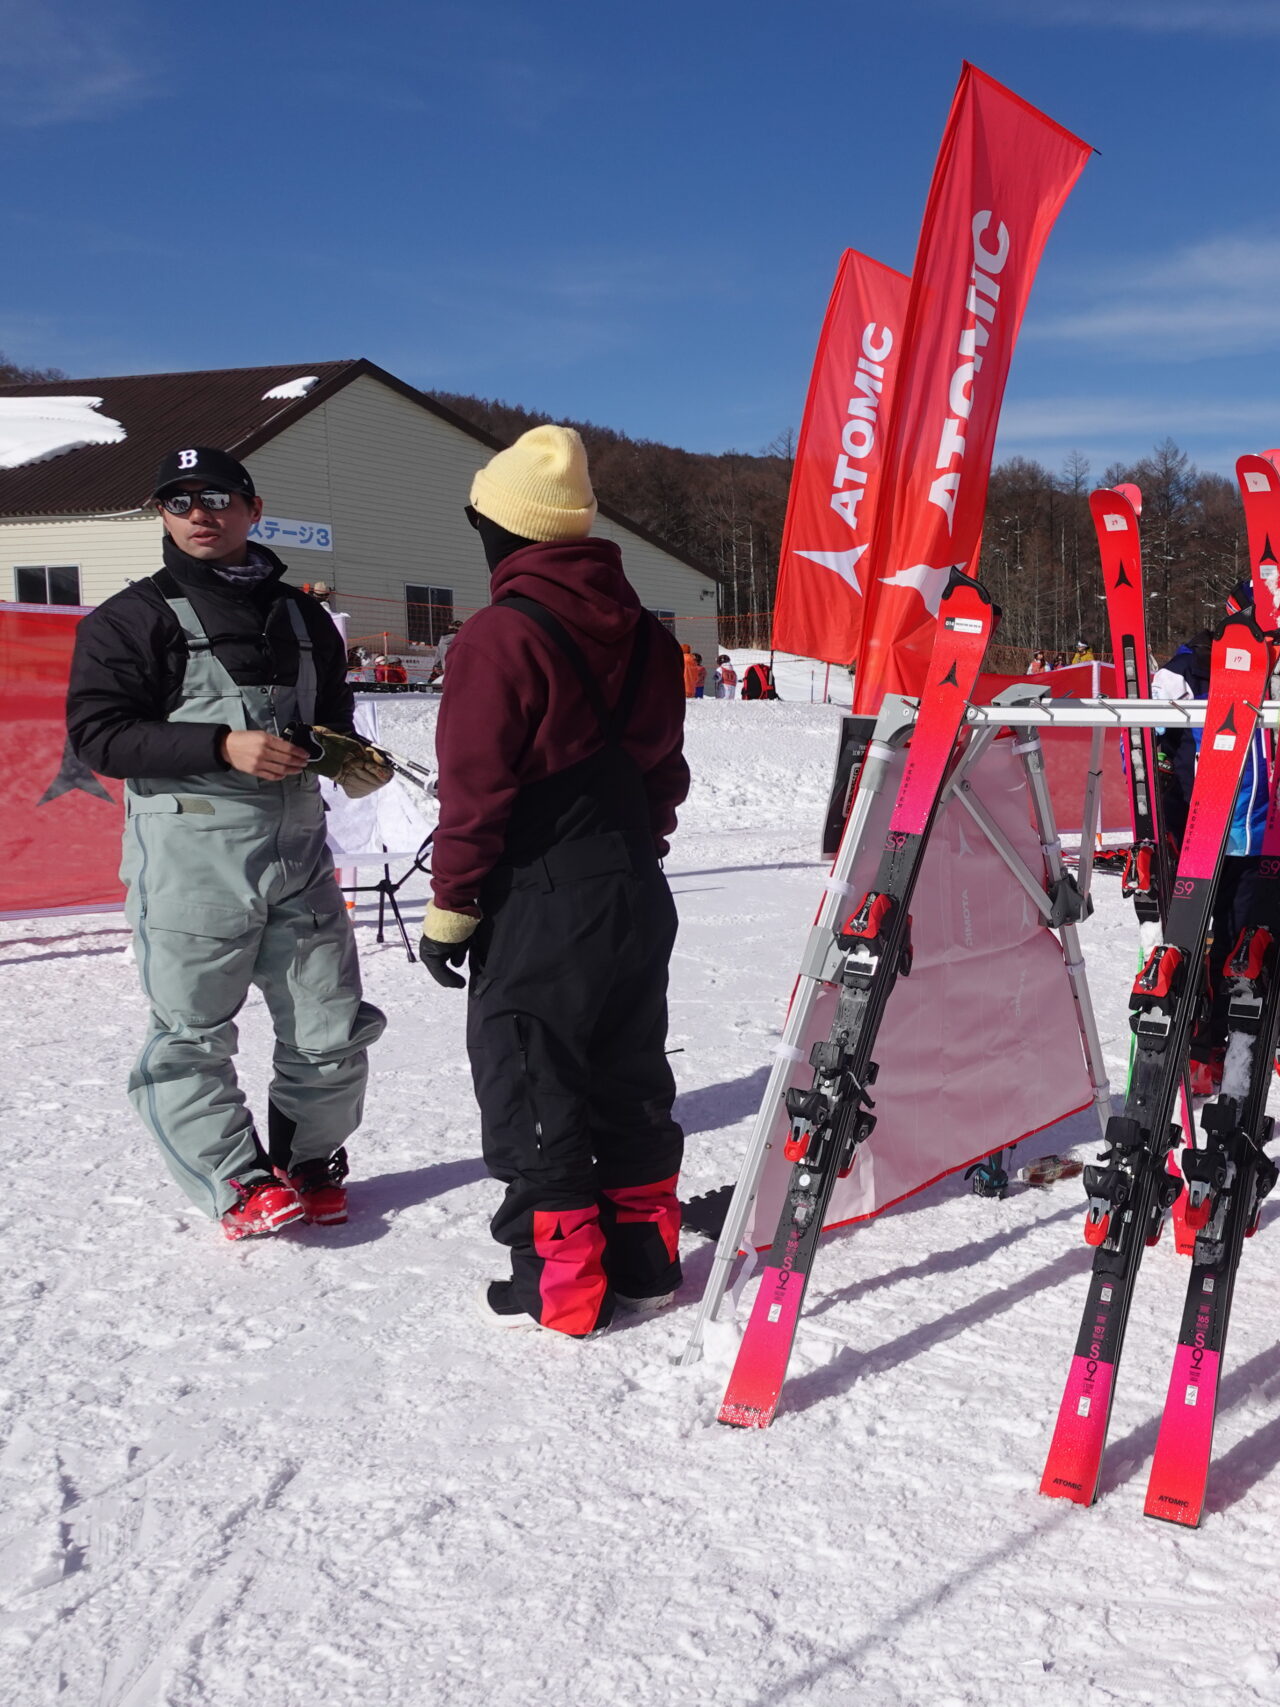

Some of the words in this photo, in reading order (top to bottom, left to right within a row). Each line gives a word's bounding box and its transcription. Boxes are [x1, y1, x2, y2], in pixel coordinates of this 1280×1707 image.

[928, 209, 1010, 536] ATOMIC
[830, 322, 892, 530] ATOMIC
[177, 449, 198, 469] B
[885, 834, 907, 849] S9
[1260, 859, 1280, 875] S9
[1174, 880, 1195, 896] S9
[1197, 1314, 1210, 1323] 165
[1053, 1477, 1083, 1492] ATOMIC
[1158, 1494, 1190, 1508] ATOMIC
